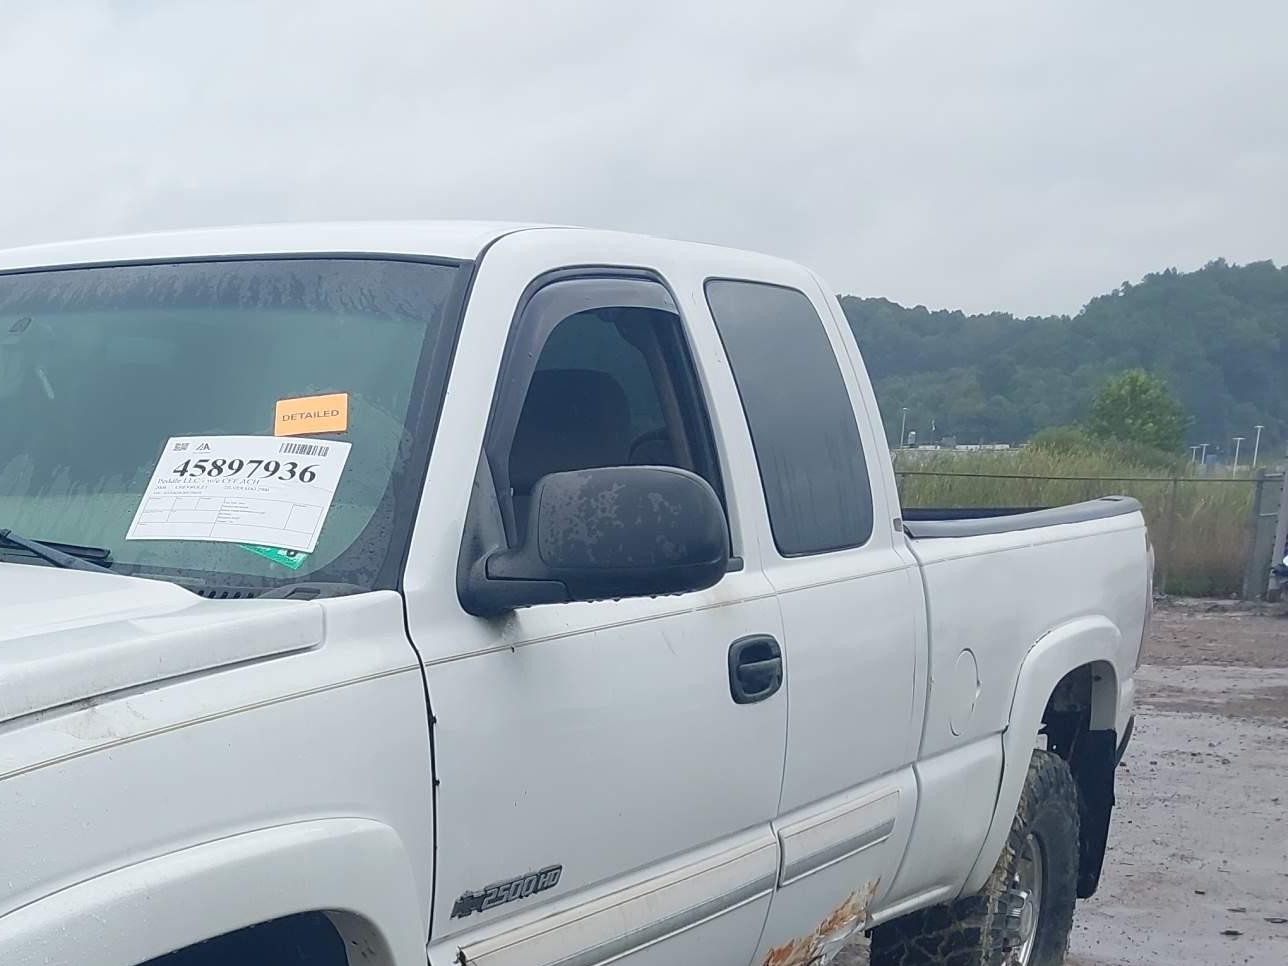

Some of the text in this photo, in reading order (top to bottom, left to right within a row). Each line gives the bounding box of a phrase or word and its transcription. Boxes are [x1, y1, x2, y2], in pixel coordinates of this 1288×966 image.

[282, 408, 340, 422] DETAILED
[173, 458, 321, 484] 45897936
[481, 874, 537, 910] 2500
